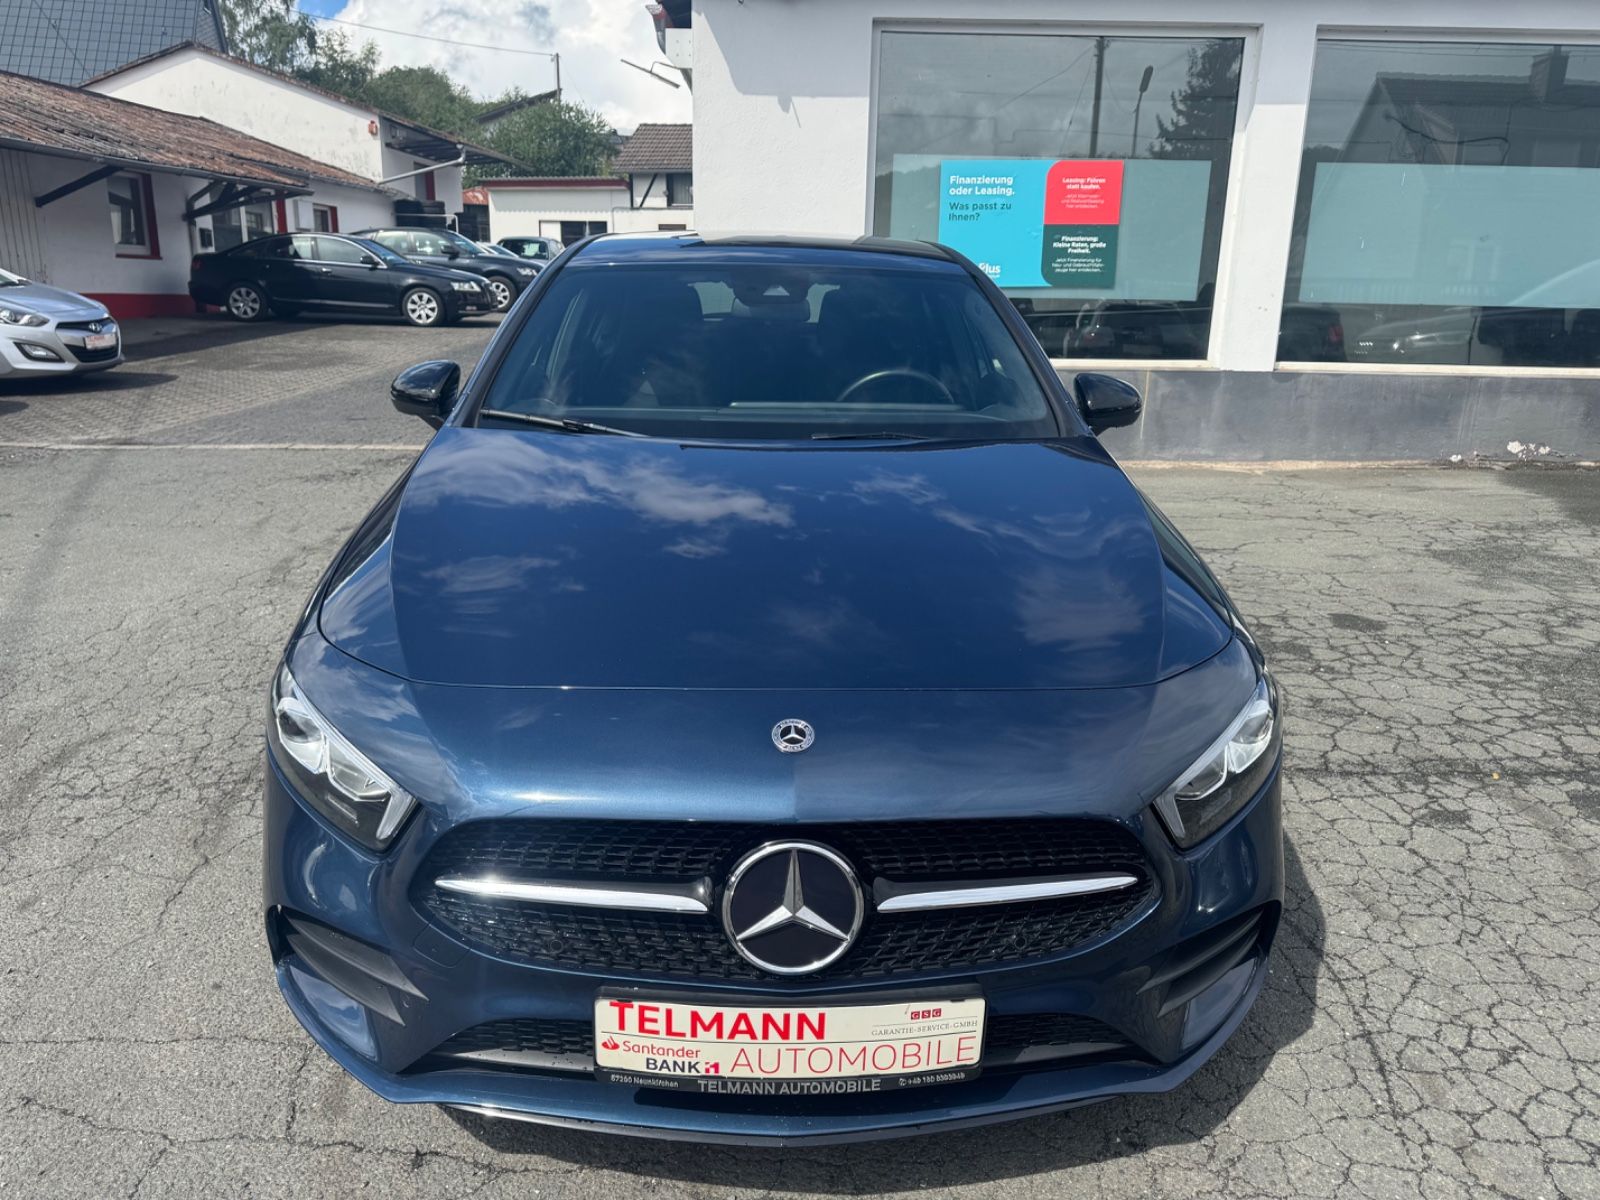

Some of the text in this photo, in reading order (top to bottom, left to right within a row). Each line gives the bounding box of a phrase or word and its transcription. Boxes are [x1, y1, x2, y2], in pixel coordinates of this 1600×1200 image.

[949, 175, 1014, 185] Finanzierung
[949, 186, 1015, 196] oder Leasing.
[949, 202, 969, 210] Was
[972, 202, 997, 211] passt
[949, 213, 980, 221] Ihnen?
[911, 1008, 942, 1020] GSG
[610, 1001, 826, 1041] TELMANN
[622, 1040, 701, 1058] Santander
[730, 1036, 978, 1075] AUTOMOBILE
[633, 1077, 679, 1088] Neunkirchen
[698, 1079, 881, 1095] TELMANN AUTOMOBILE
